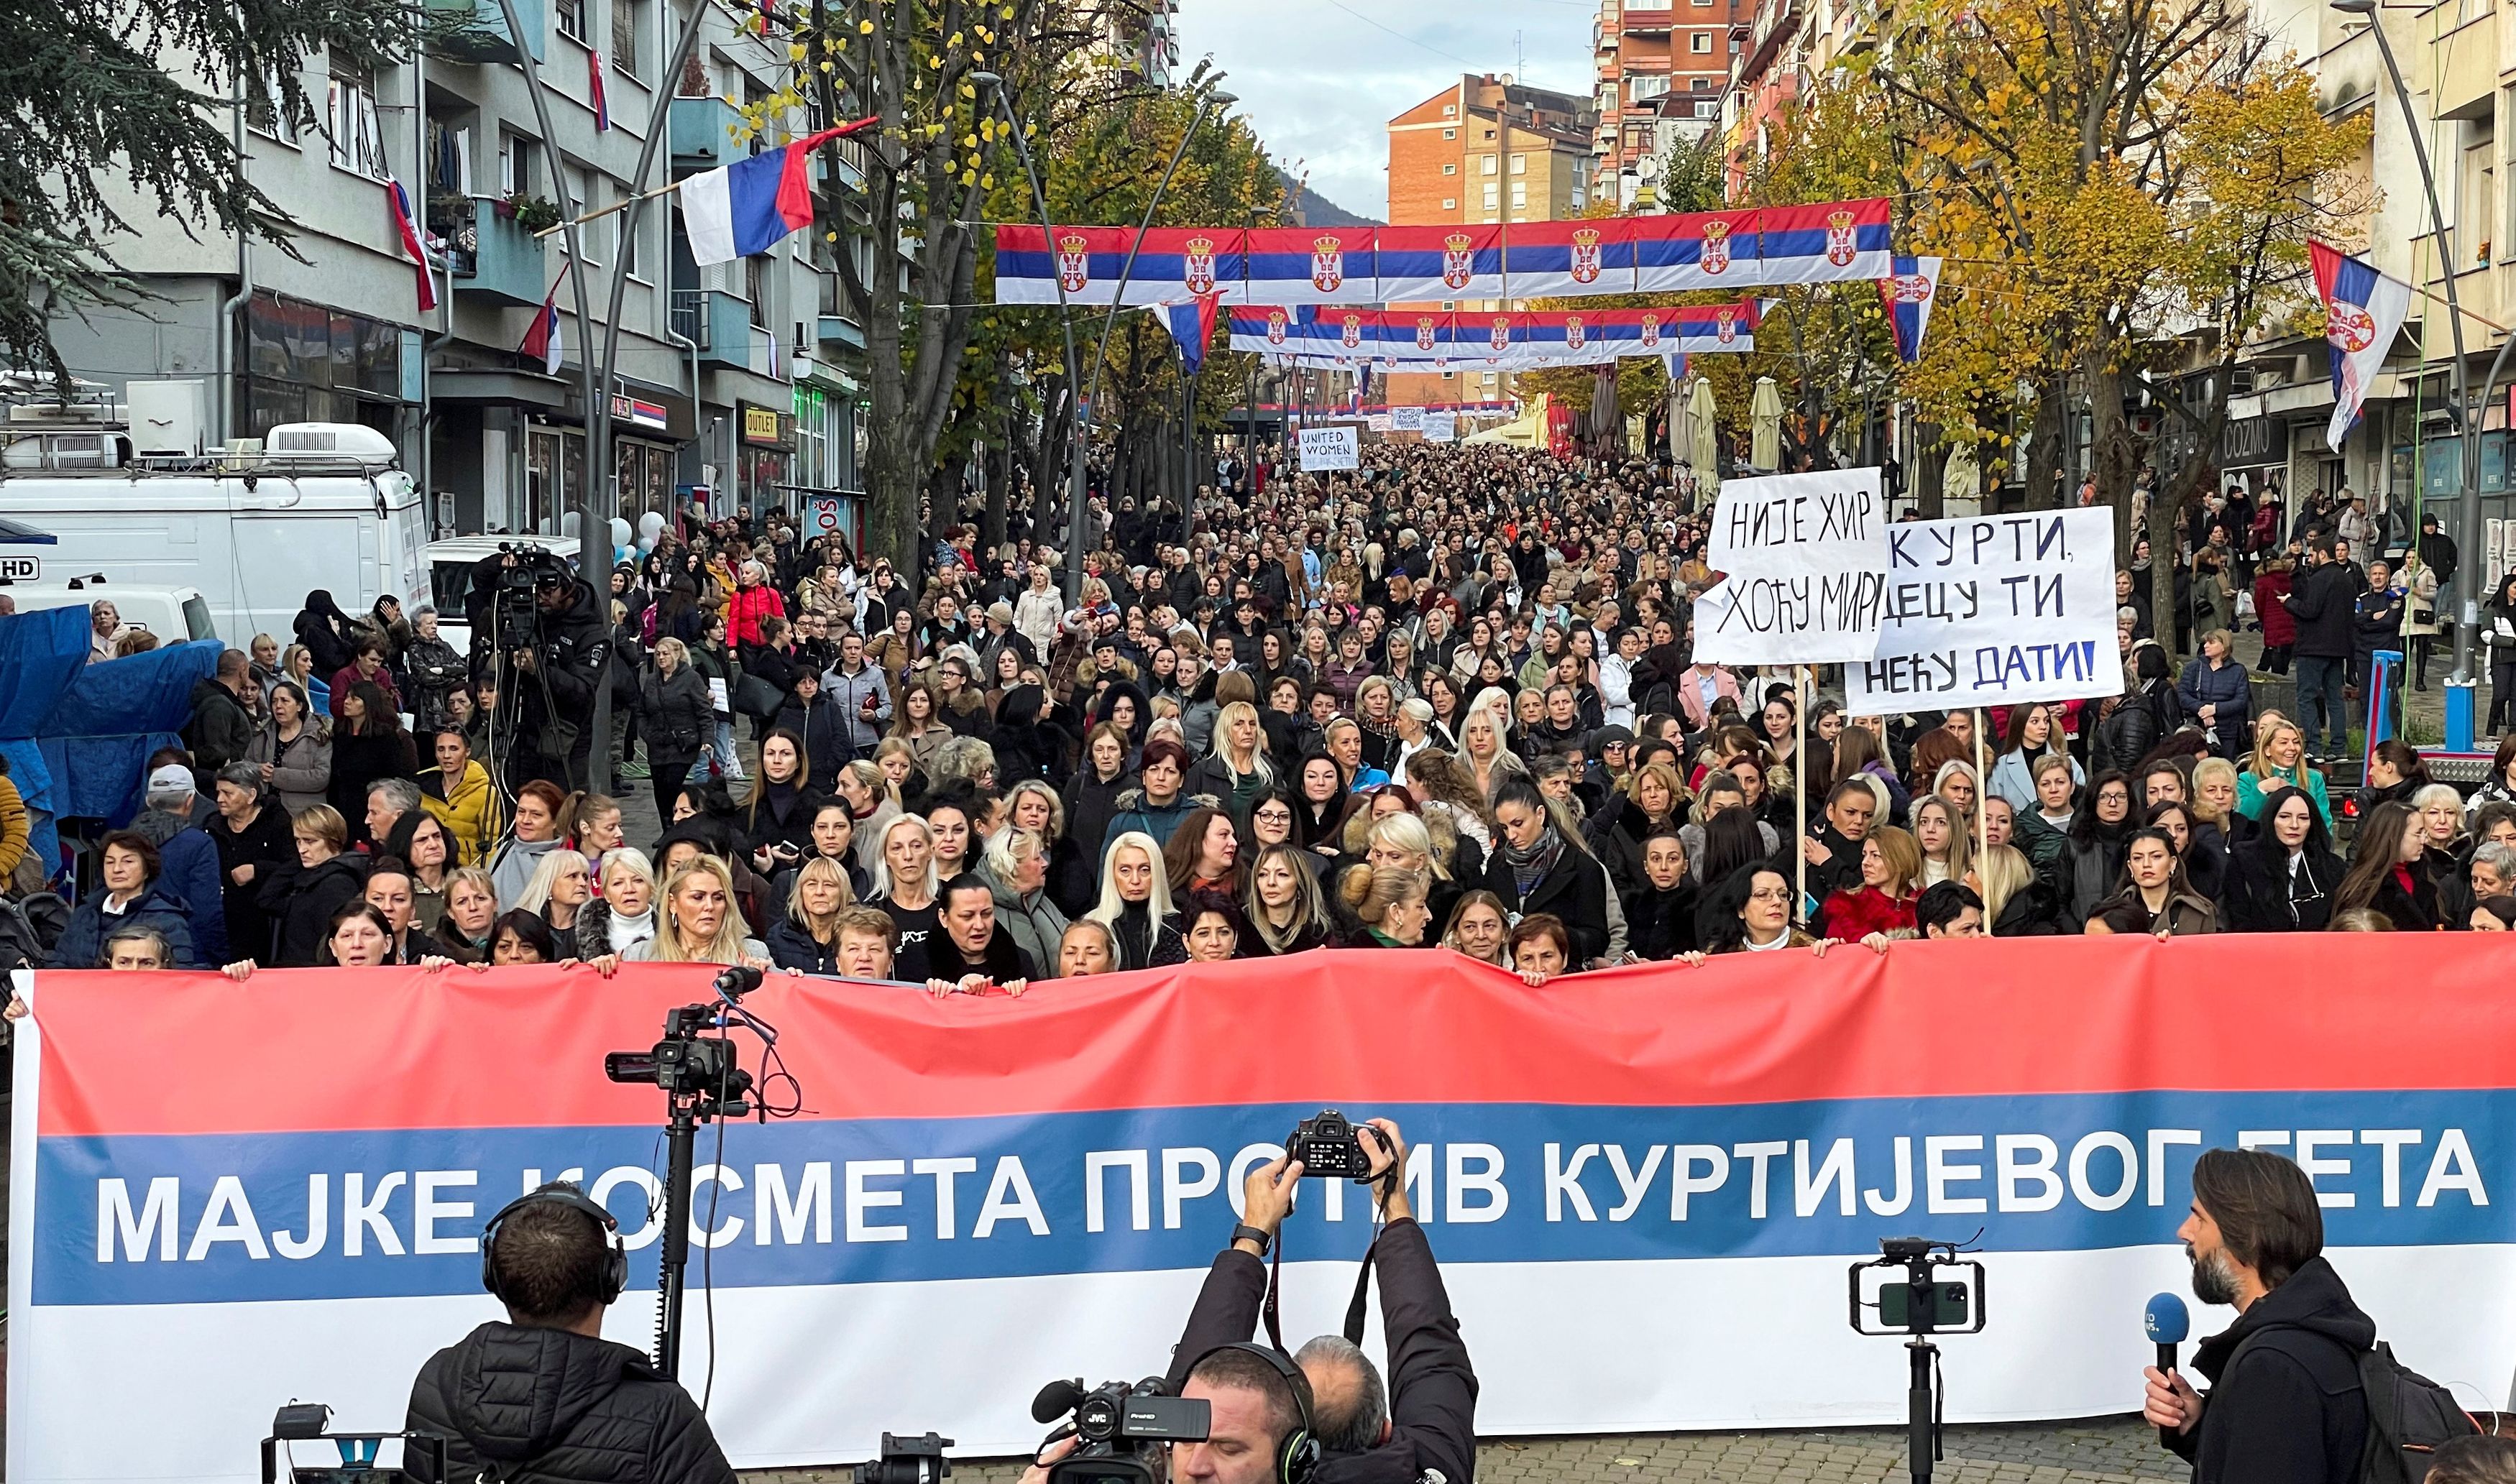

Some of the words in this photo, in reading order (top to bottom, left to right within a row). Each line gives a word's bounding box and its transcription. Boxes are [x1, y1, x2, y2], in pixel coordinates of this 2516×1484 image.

[748, 413, 774, 433] OUTLET
[1302, 431, 1344, 443] UNITED
[2224, 419, 2269, 460] COZMO
[1306, 444, 1350, 456] WOMEN
[814, 500, 837, 540] OŠ
[1730, 497, 1807, 549] НИЈЕ
[1819, 491, 1870, 541] ХИР
[1891, 516, 2073, 568] КУРТИ,
[1, 561, 34, 576] HD
[1717, 576, 1809, 634] ХОЋУ
[1821, 571, 1886, 632] МИР!
[2001, 573, 2064, 617] ТИ
[1865, 650, 1957, 693] НЕЋУ
[1973, 641, 2095, 690] ДАТИ!
[98, 1170, 479, 1262] МАЈКЕ
[1543, 1129, 2201, 1222] КУРТИЈЕВОГ
[1088, 1414, 1106, 1423] JVC
